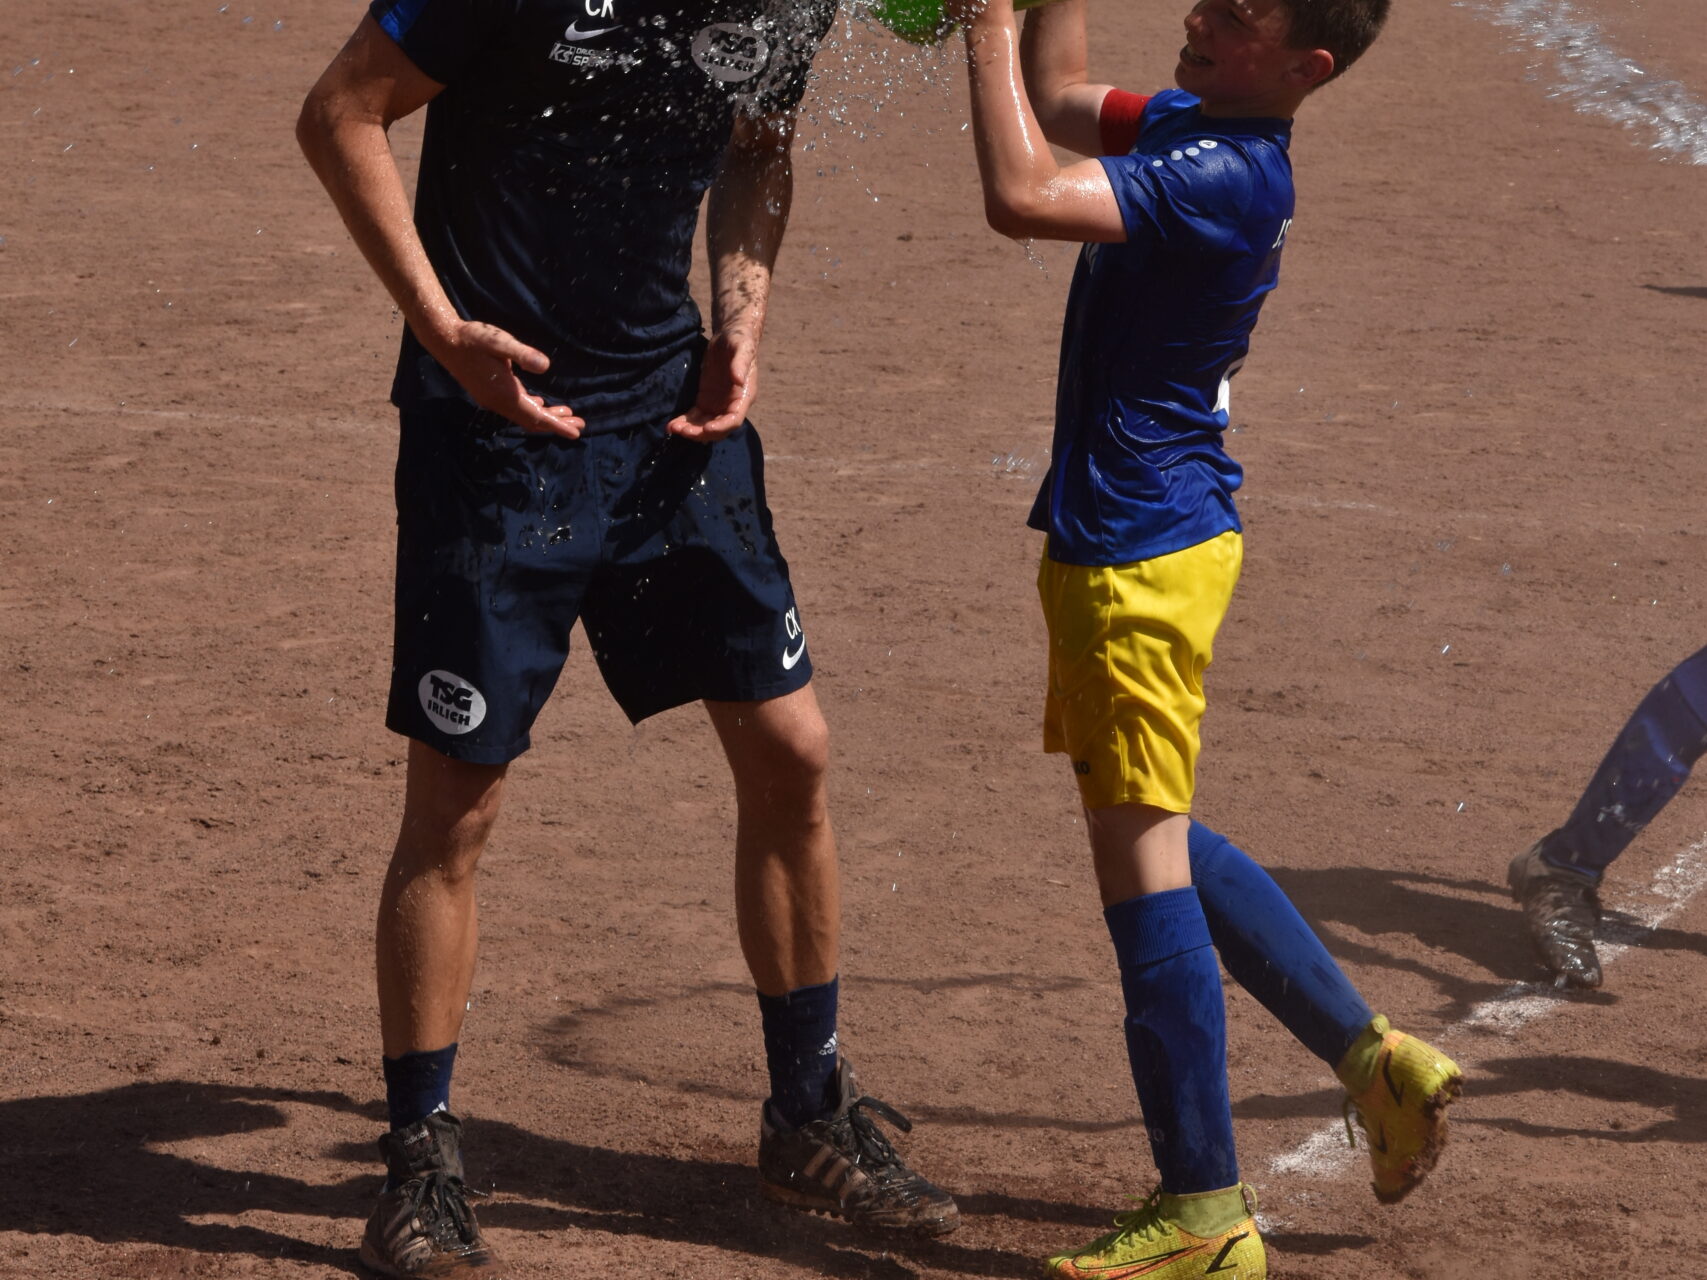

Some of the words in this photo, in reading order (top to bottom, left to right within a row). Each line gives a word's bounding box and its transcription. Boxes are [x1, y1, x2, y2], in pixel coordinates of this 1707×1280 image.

[708, 28, 757, 59] TSG
[785, 606, 802, 640] CK
[430, 673, 473, 712] TSG
[427, 699, 471, 726] IRLICH
